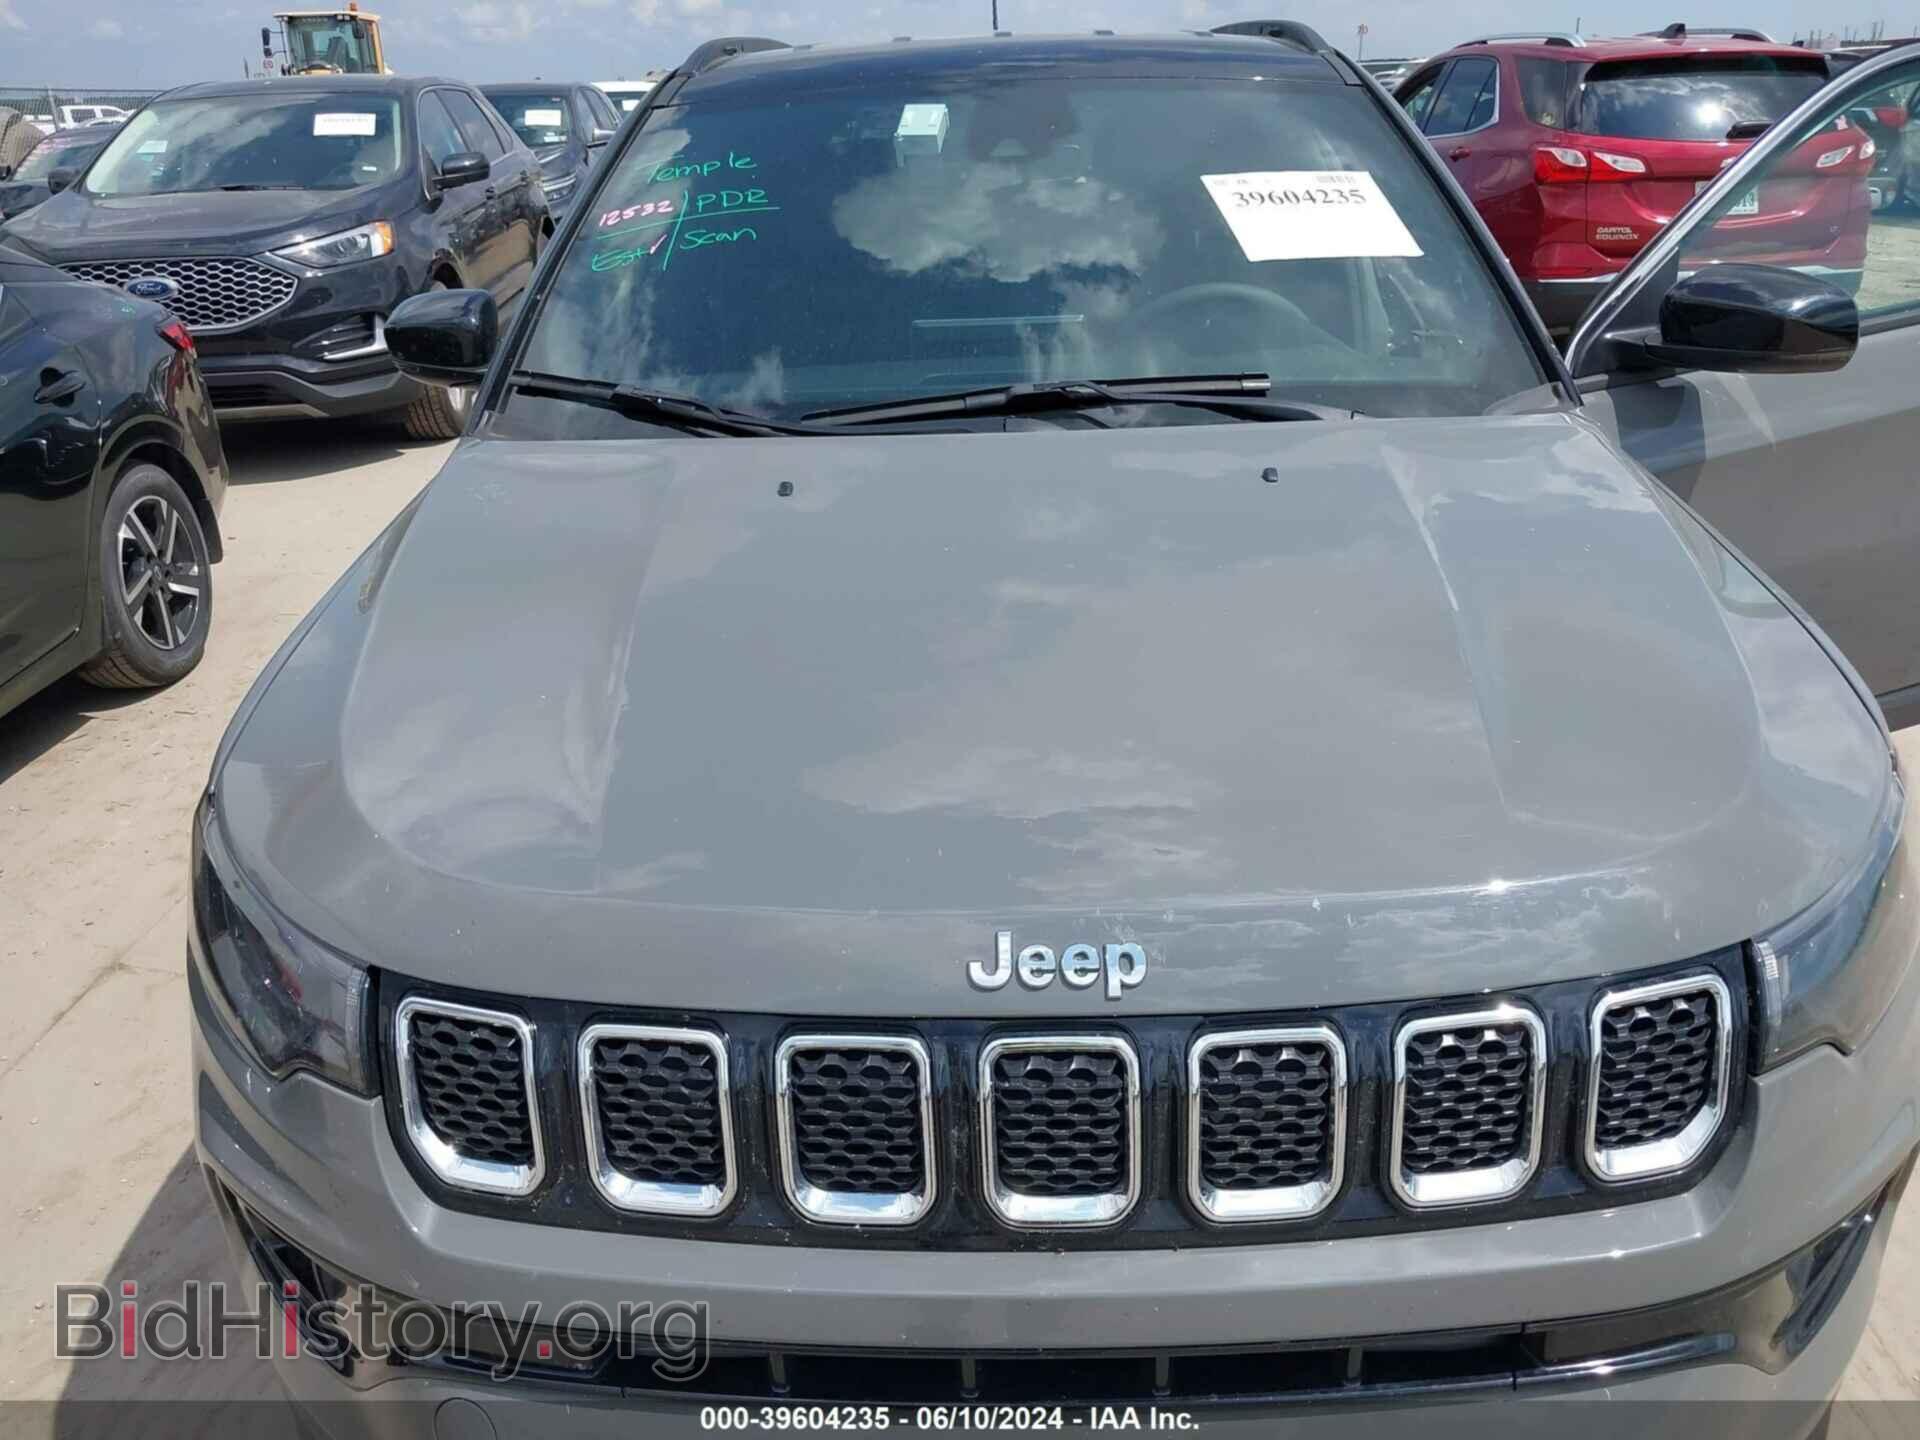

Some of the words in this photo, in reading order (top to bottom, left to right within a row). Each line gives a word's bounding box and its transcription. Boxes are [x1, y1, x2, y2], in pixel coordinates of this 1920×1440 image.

[1231, 188, 1367, 208] 39604235
[599, 200, 675, 226] 12532
[679, 227, 757, 250] Scan
[967, 930, 1147, 1001] Jeep
